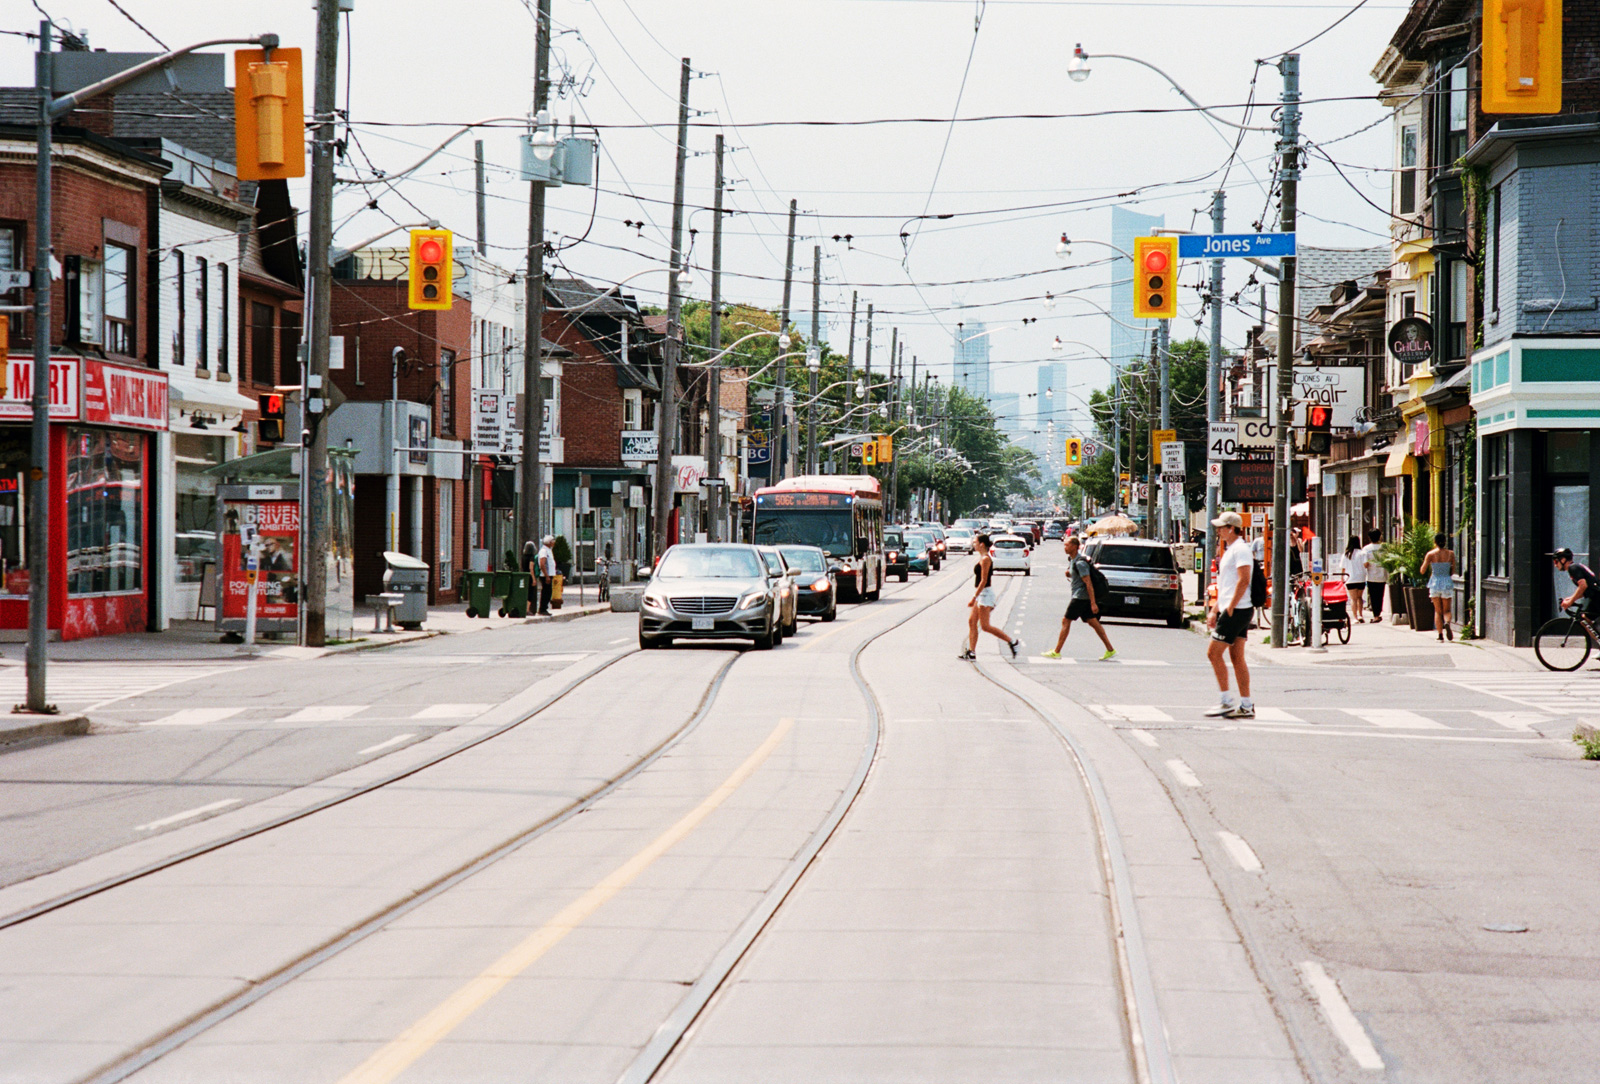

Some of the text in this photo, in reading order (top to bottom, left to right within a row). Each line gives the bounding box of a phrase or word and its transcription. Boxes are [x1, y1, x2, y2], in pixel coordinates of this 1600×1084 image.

[1203, 235, 1272, 253] Jones Ave
[1301, 375, 1320, 383] JONES
[13, 363, 70, 405] MRT
[477, 424, 499, 432] Inspired
[477, 440, 499, 448] Training
[1211, 438, 1236, 456] 40
[748, 448, 767, 459] BC
[1238, 489, 1259, 498] JULY
[246, 513, 299, 524] DRIVEN
[229, 581, 281, 589] POWRING
[257, 588, 280, 596] UTURE
